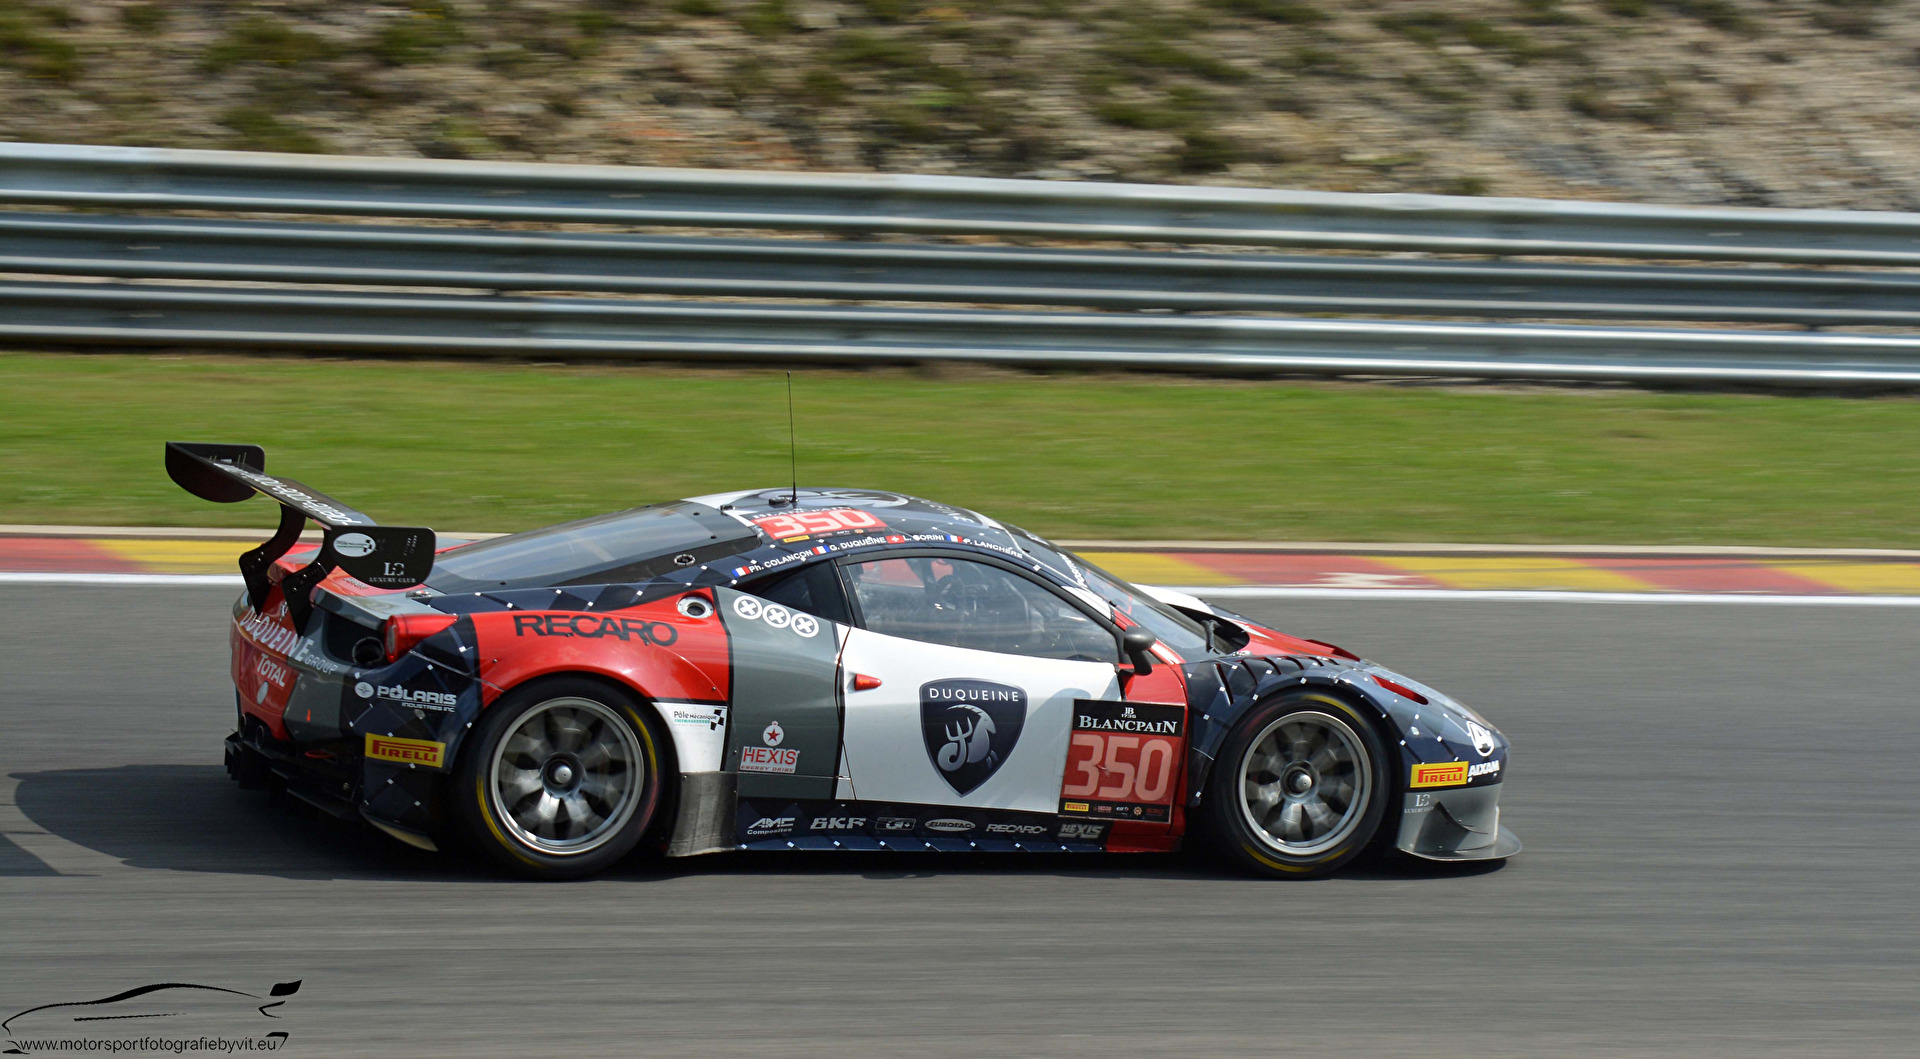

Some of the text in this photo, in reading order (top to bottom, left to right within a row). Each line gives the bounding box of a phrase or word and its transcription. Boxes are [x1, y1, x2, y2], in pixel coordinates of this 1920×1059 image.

[755, 509, 876, 537] 350
[829, 536, 887, 552] G. DUQUEINE
[749, 563, 764, 573] Ph.
[240, 604, 315, 662] DUQUEINE
[304, 655, 339, 675] GROUP
[513, 614, 679, 648] RECARO
[256, 652, 287, 688] TOTAL
[377, 685, 457, 706] POLARIS
[929, 688, 1019, 702] DUQUEINE
[673, 710, 690, 719] Pôle
[1079, 715, 1178, 734] BLANCPAIN
[372, 739, 438, 763] PIRELLI
[743, 748, 797, 765] HEXIS
[1063, 733, 1173, 802] 350
[1418, 767, 1463, 784] PIRELLI
[1468, 760, 1500, 777] AIXAM
[747, 827, 793, 835] Composites
[985, 823, 1042, 834] RECARO
[1060, 823, 1104, 835] HEXIS
